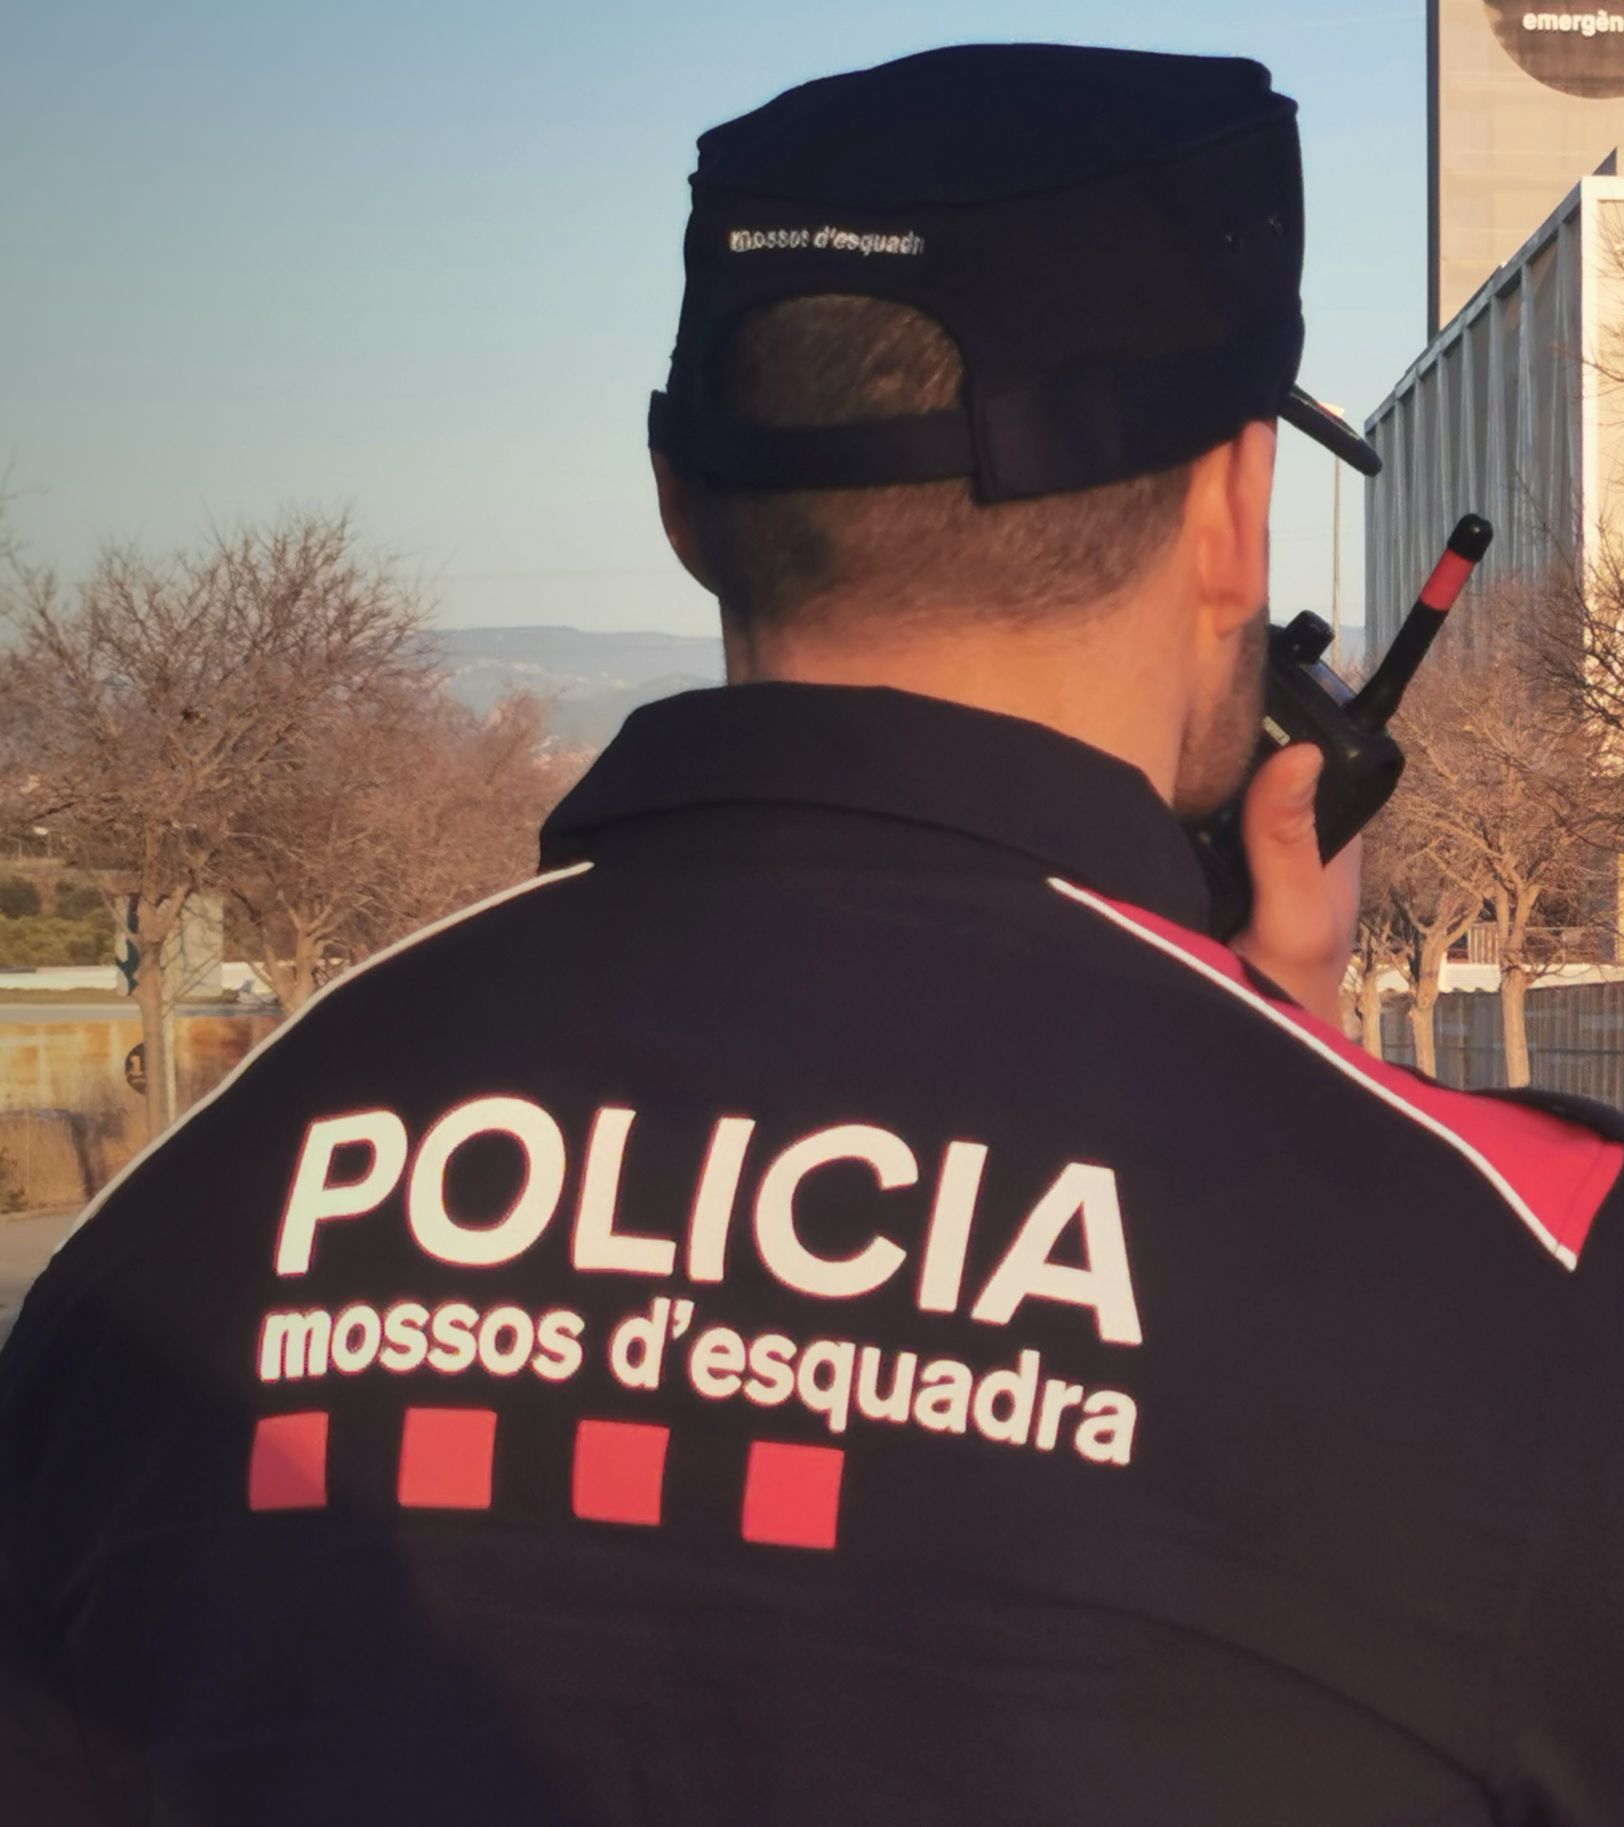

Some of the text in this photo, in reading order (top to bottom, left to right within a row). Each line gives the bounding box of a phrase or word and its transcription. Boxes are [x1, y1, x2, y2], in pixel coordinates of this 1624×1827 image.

[729, 228, 810, 253] mossos
[276, 1096, 1143, 1346] POLICIA
[259, 1296, 1137, 1466] mossos d'esquadra
